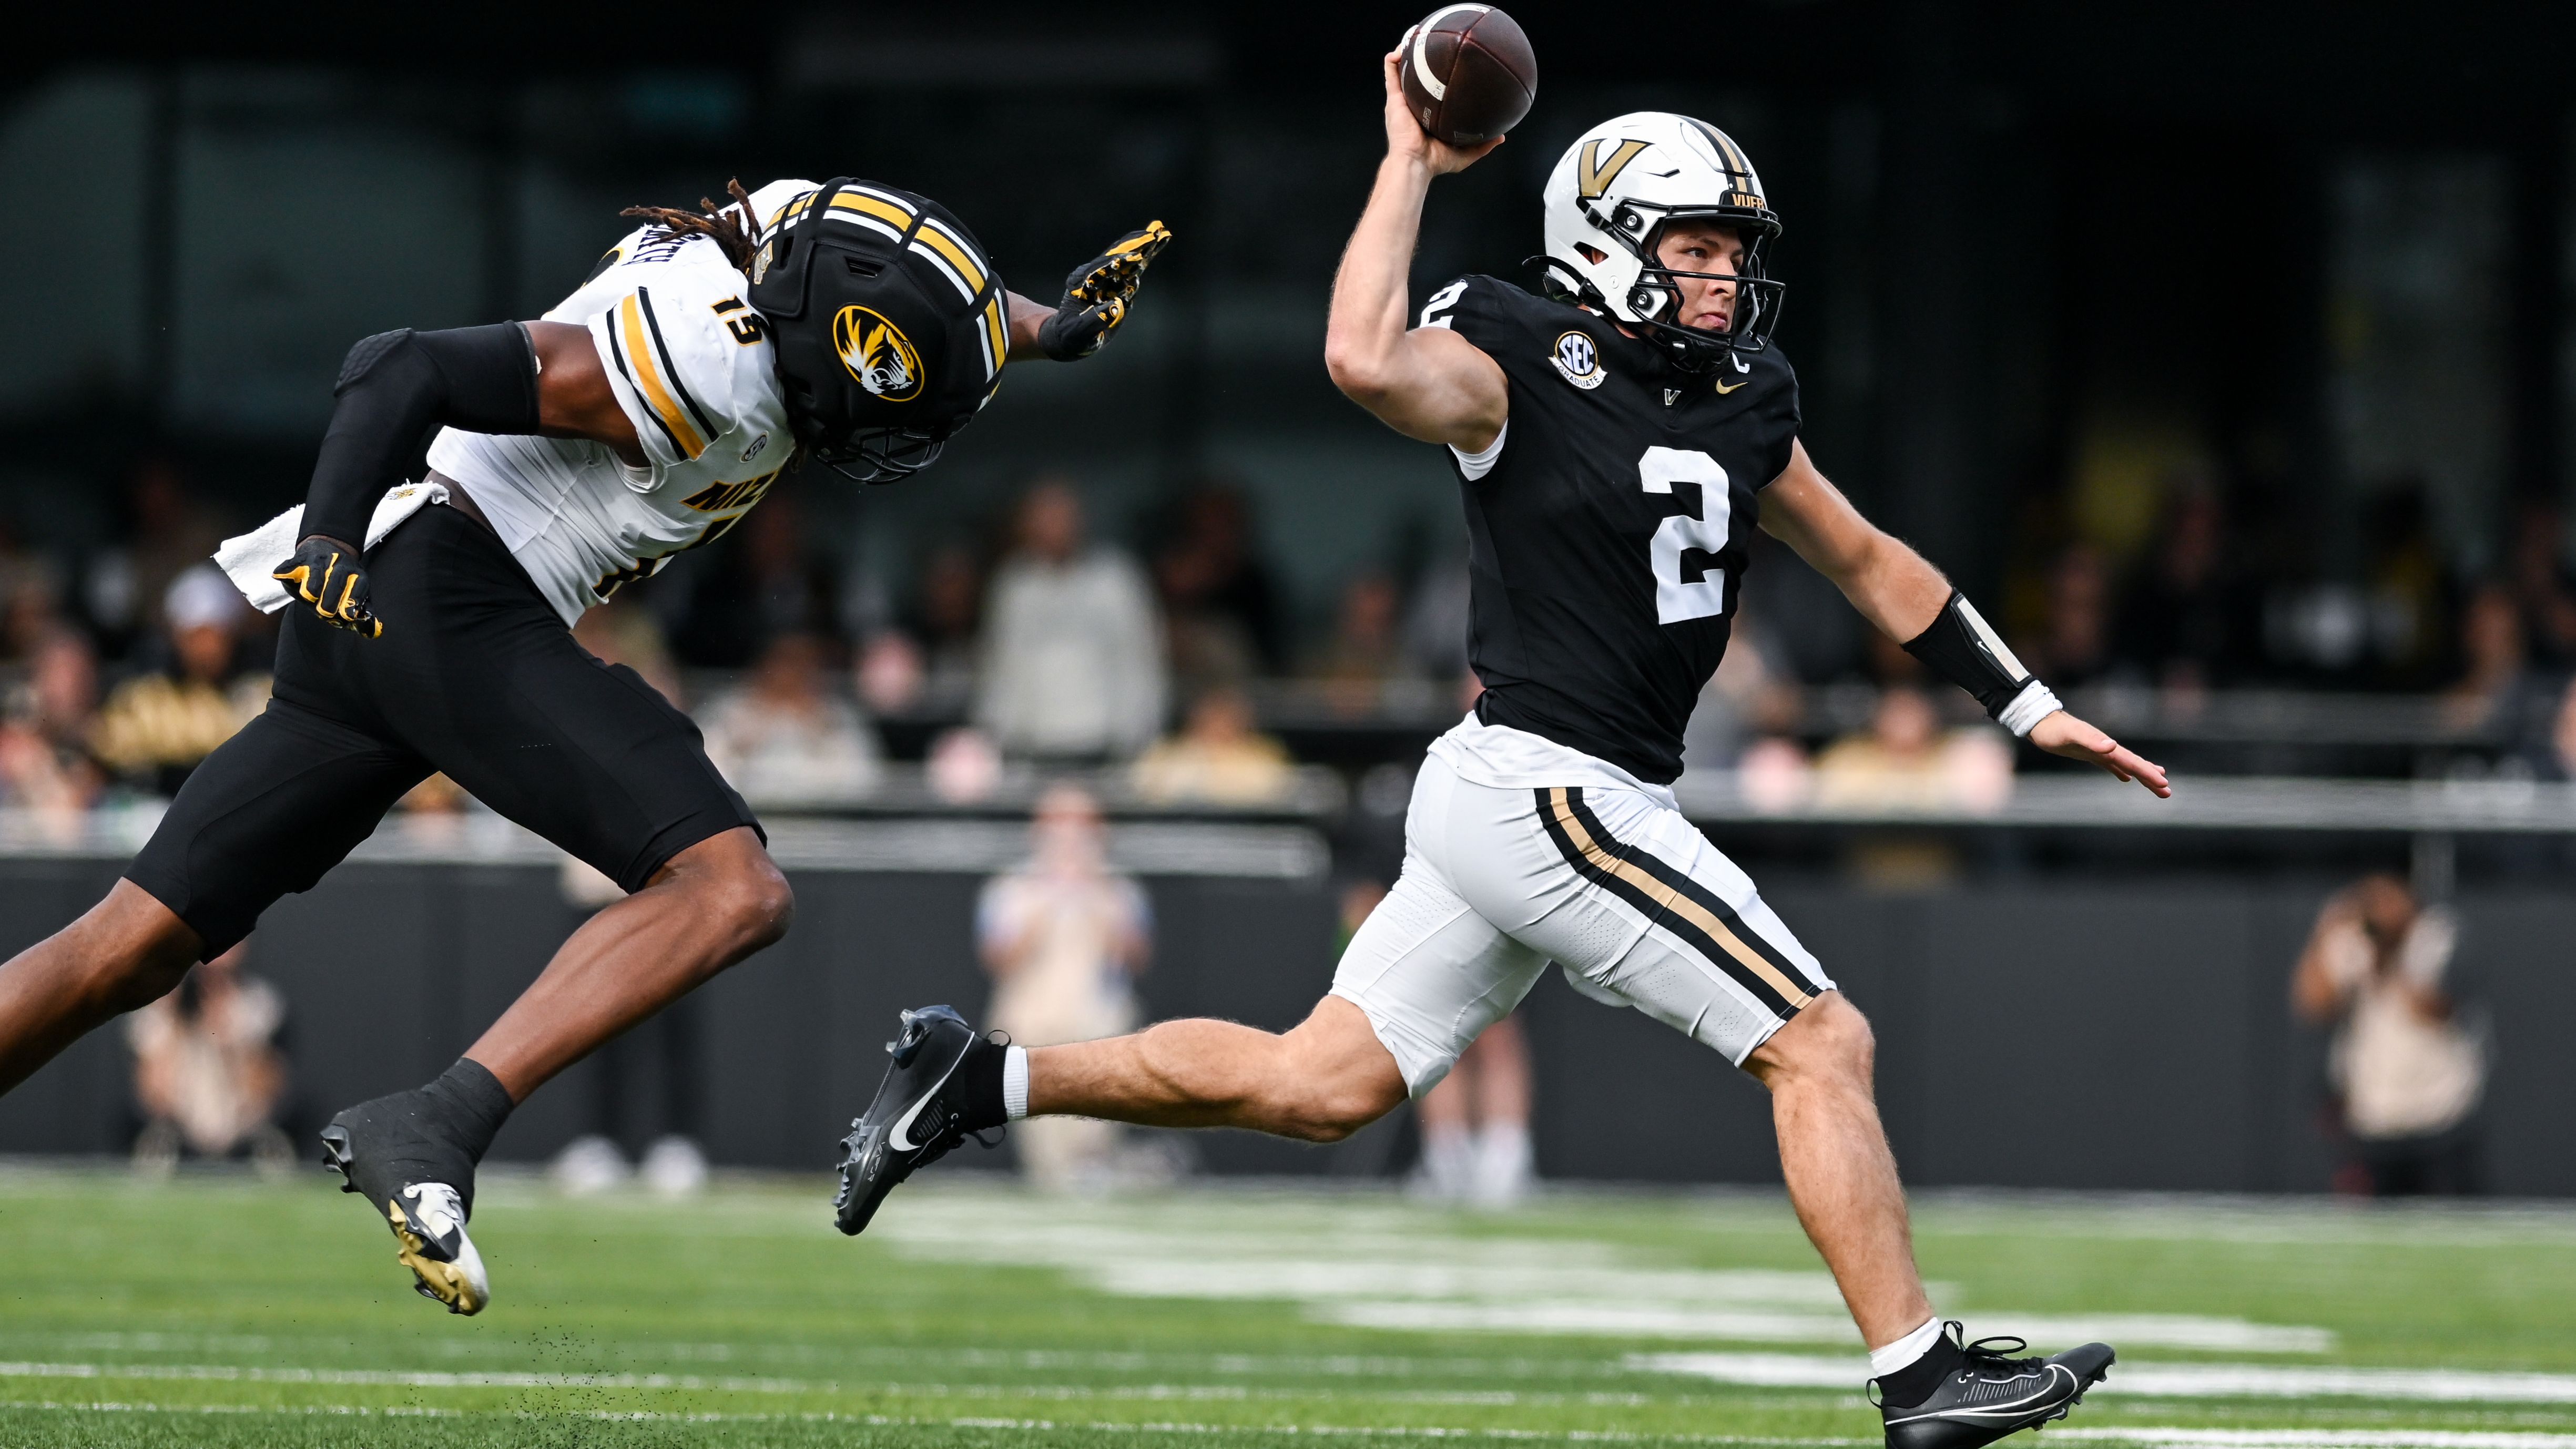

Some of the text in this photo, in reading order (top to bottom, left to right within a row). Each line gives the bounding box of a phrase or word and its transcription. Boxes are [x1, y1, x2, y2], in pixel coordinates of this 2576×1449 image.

[1577, 138, 1655, 200] V
[710, 293, 762, 348] 19
[1419, 281, 1469, 330] 2
[1558, 365, 1601, 387] GRADUATE
[1559, 334, 1594, 374] SEC
[1664, 388, 1682, 406] V
[1638, 445, 1731, 625] 2
